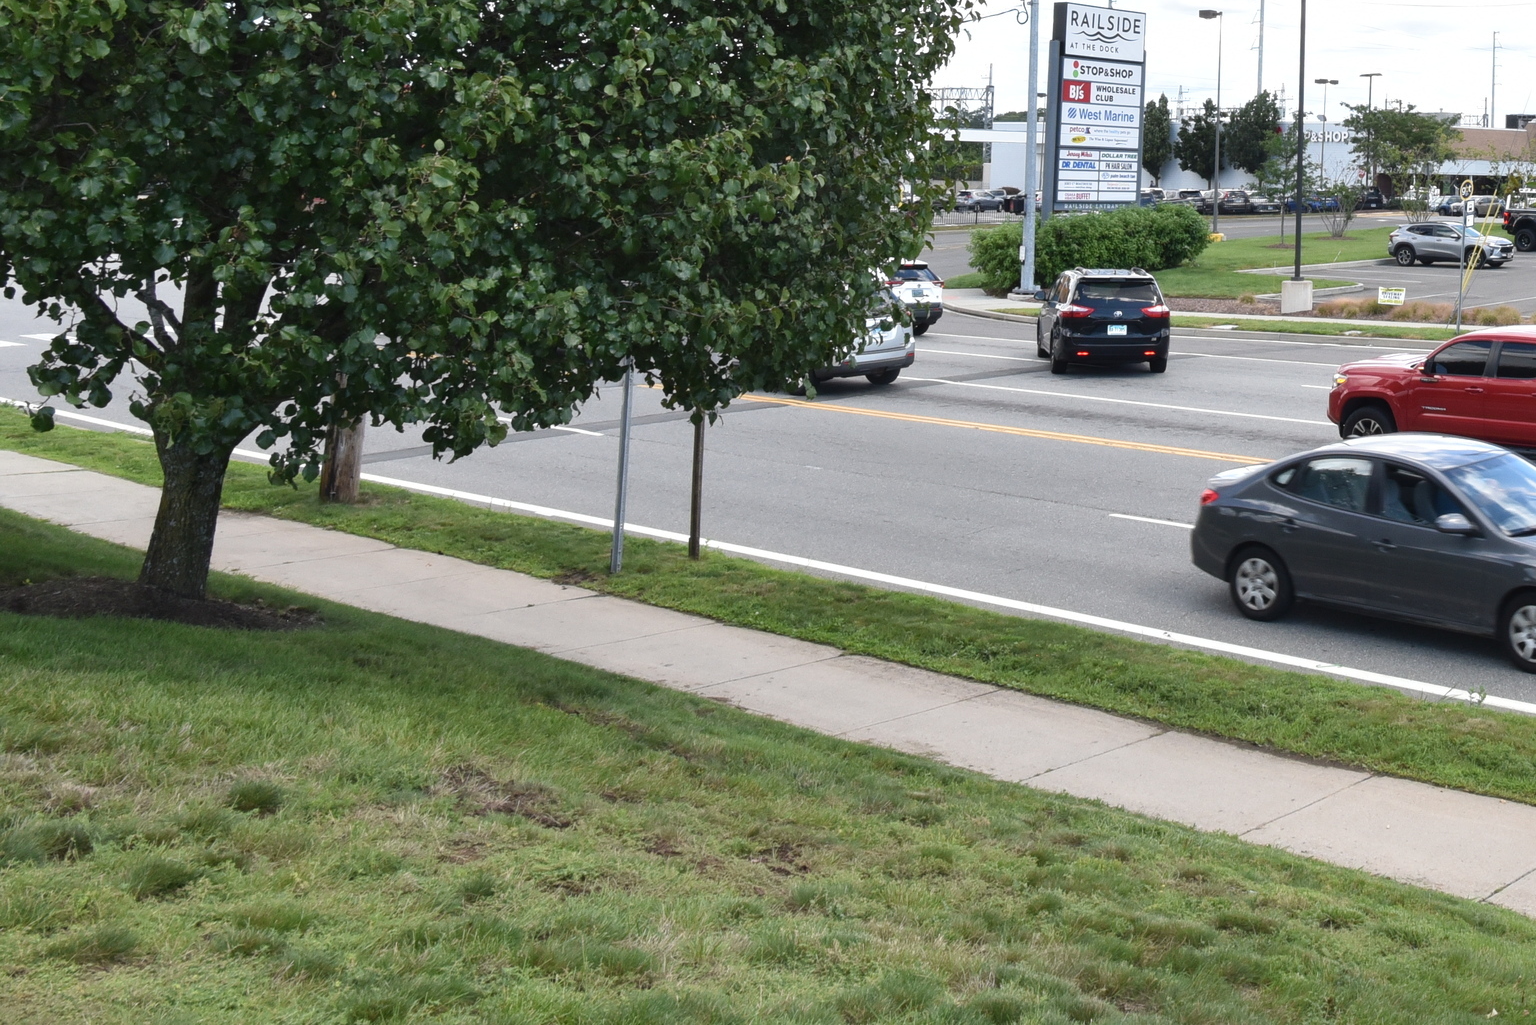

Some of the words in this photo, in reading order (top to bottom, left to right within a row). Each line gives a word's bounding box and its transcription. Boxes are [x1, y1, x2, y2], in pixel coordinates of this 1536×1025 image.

[1071, 10, 1141, 34] RAILSIDE
[1082, 43, 1096, 51] THE
[1100, 45, 1119, 53] DOCK
[1080, 65, 1133, 79] STOP&SHOP
[1069, 84, 1085, 101] BJ's
[1096, 85, 1136, 95] WHOLESALE
[1079, 108, 1102, 121] West
[1104, 110, 1134, 123] Marine
